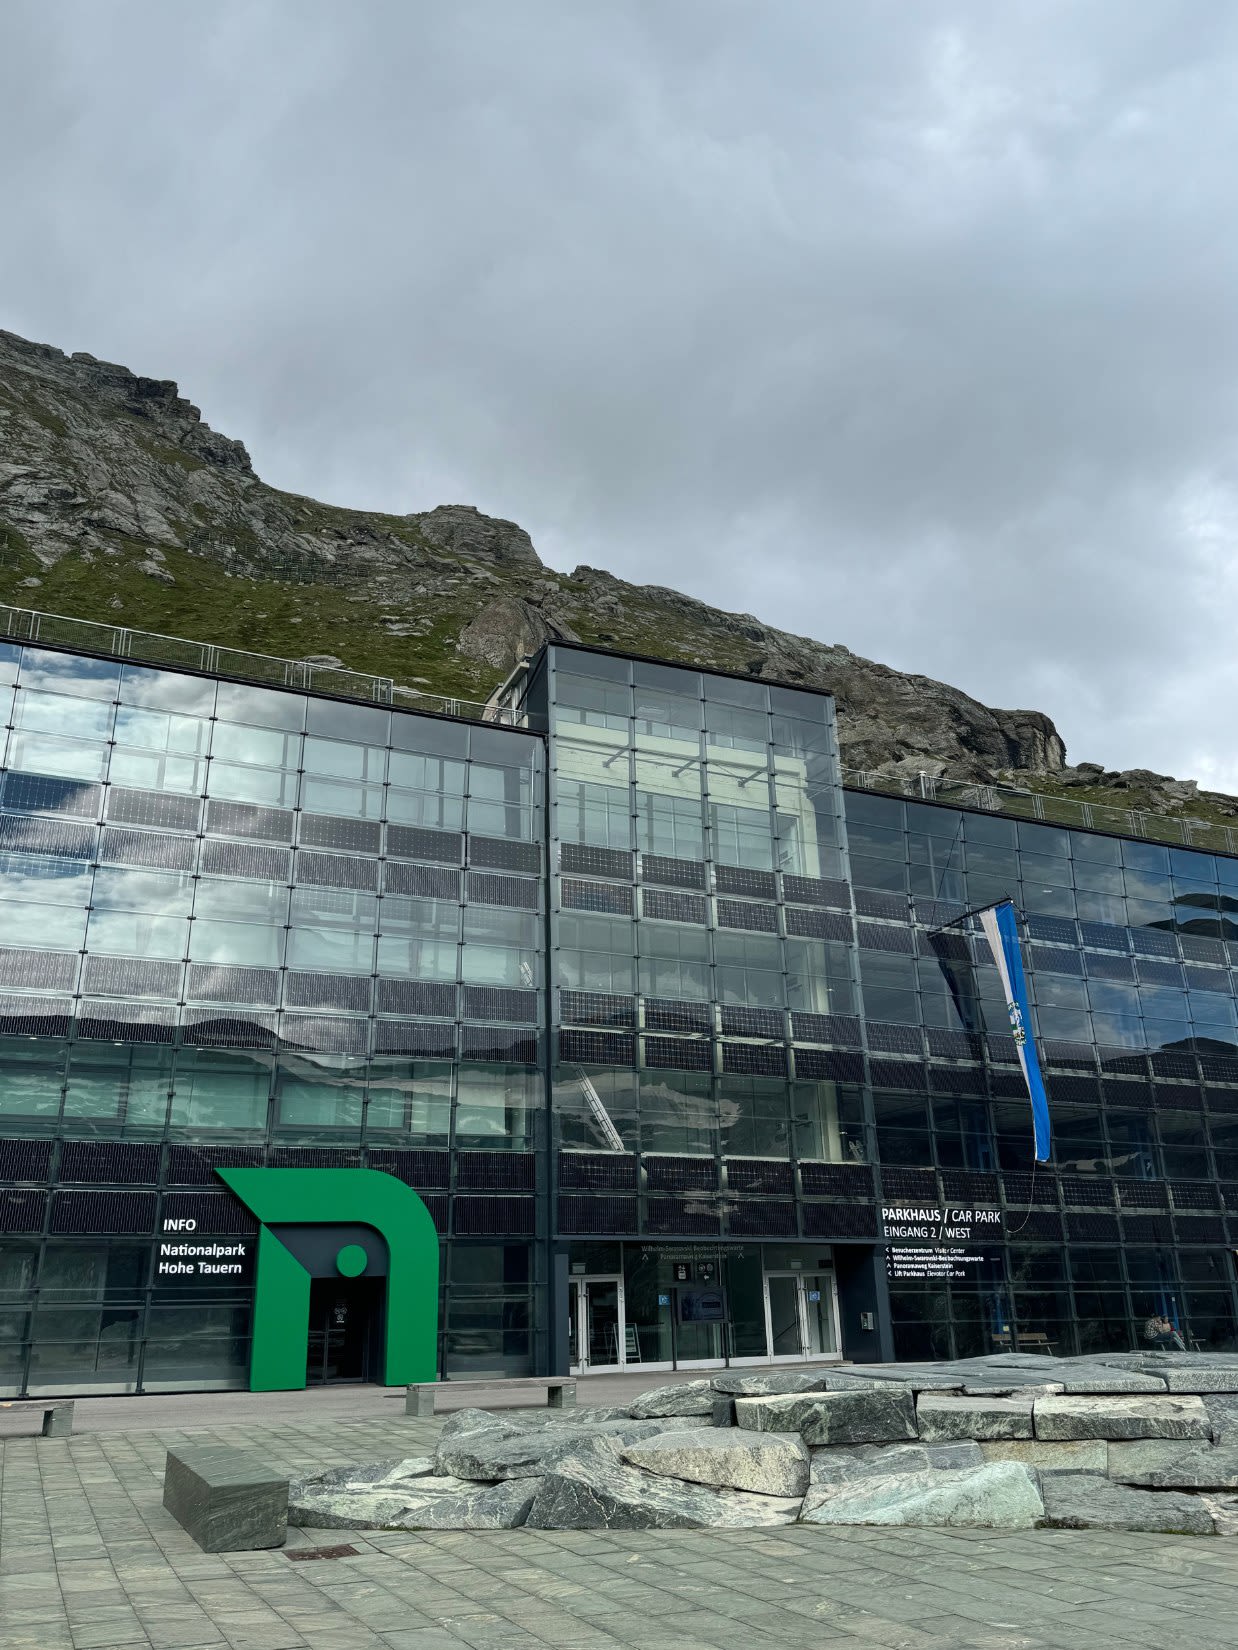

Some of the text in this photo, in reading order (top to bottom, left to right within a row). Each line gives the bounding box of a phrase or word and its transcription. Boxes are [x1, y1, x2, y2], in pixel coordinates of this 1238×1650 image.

[882, 1208, 1001, 1223] PARKHAUS / CAR PARK
[163, 1219, 196, 1231] INFO
[884, 1226, 971, 1239] EINGANG 2 / WEST
[160, 1243, 246, 1258] Nationalpark
[158, 1261, 242, 1274] Hohe Tauern
